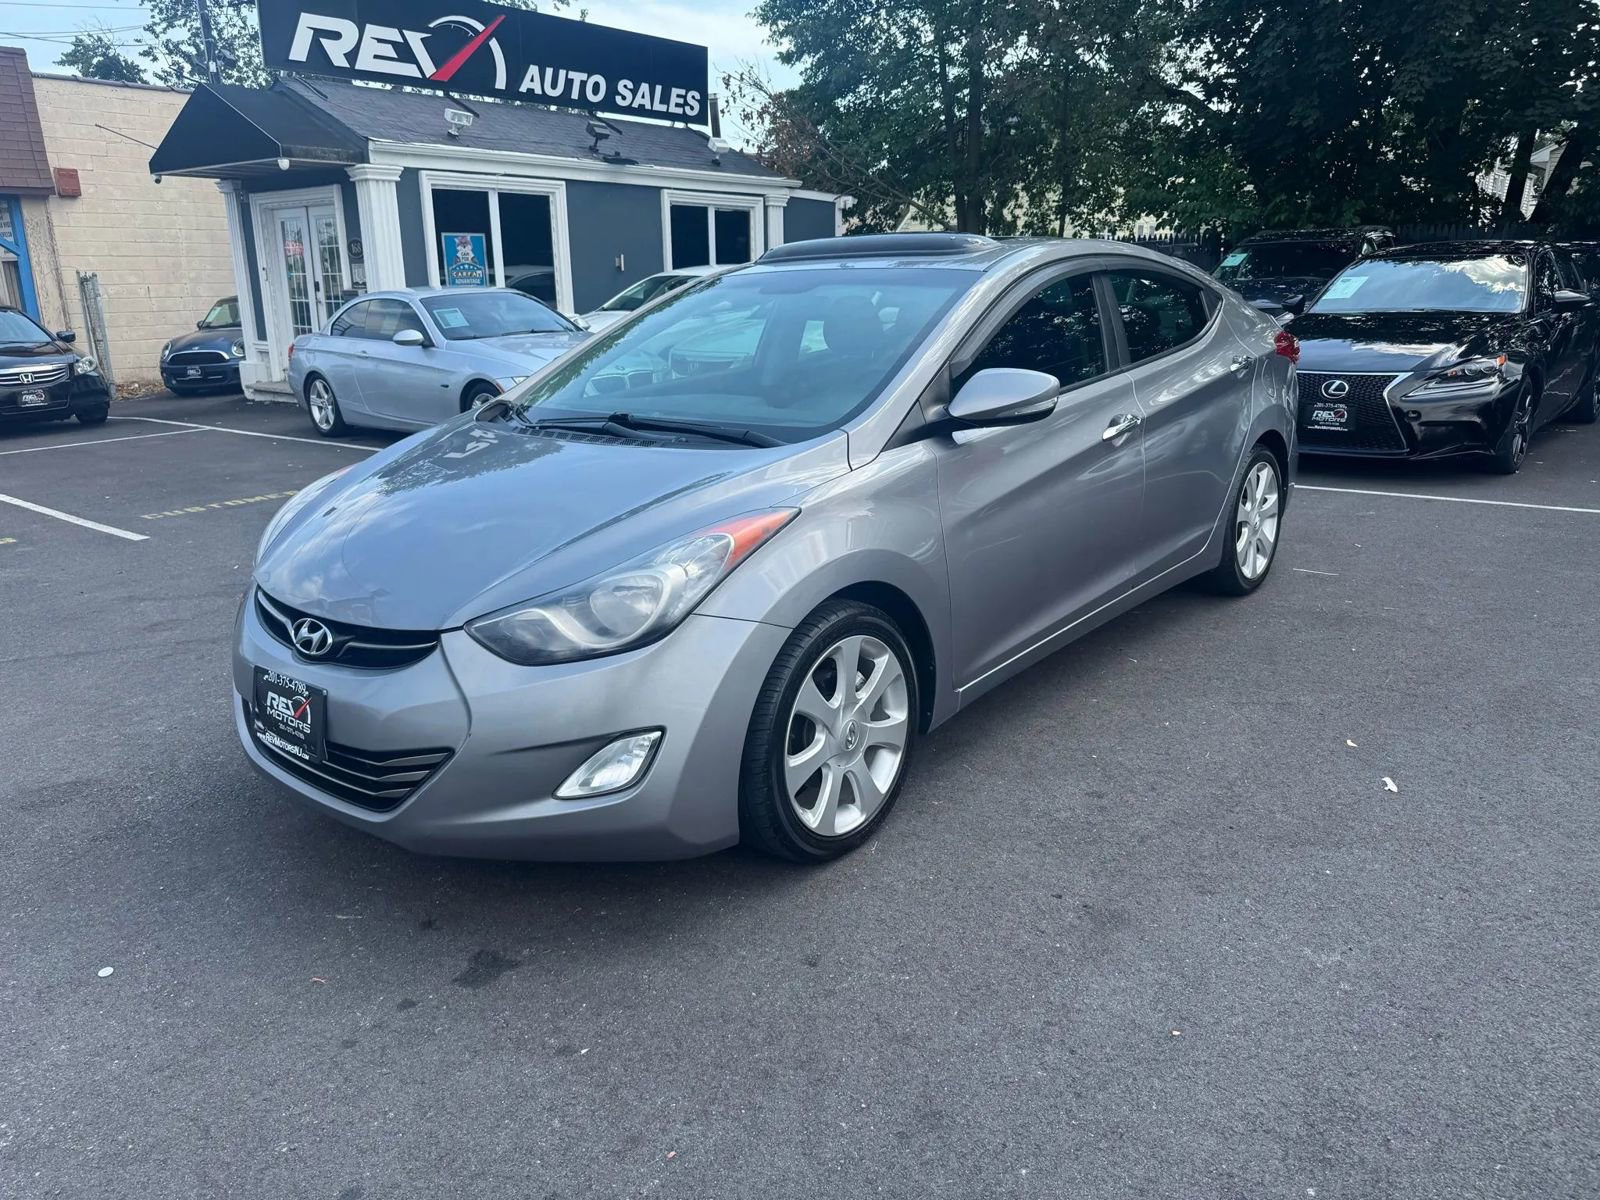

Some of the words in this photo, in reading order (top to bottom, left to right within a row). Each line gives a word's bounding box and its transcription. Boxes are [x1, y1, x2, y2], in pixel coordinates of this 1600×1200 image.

[288, 12, 506, 82] REV
[518, 64, 607, 103] AUTO
[615, 79, 701, 116] SALES
[267, 670, 307, 694] 201-375-4789
[266, 707, 311, 734] MOTORS
